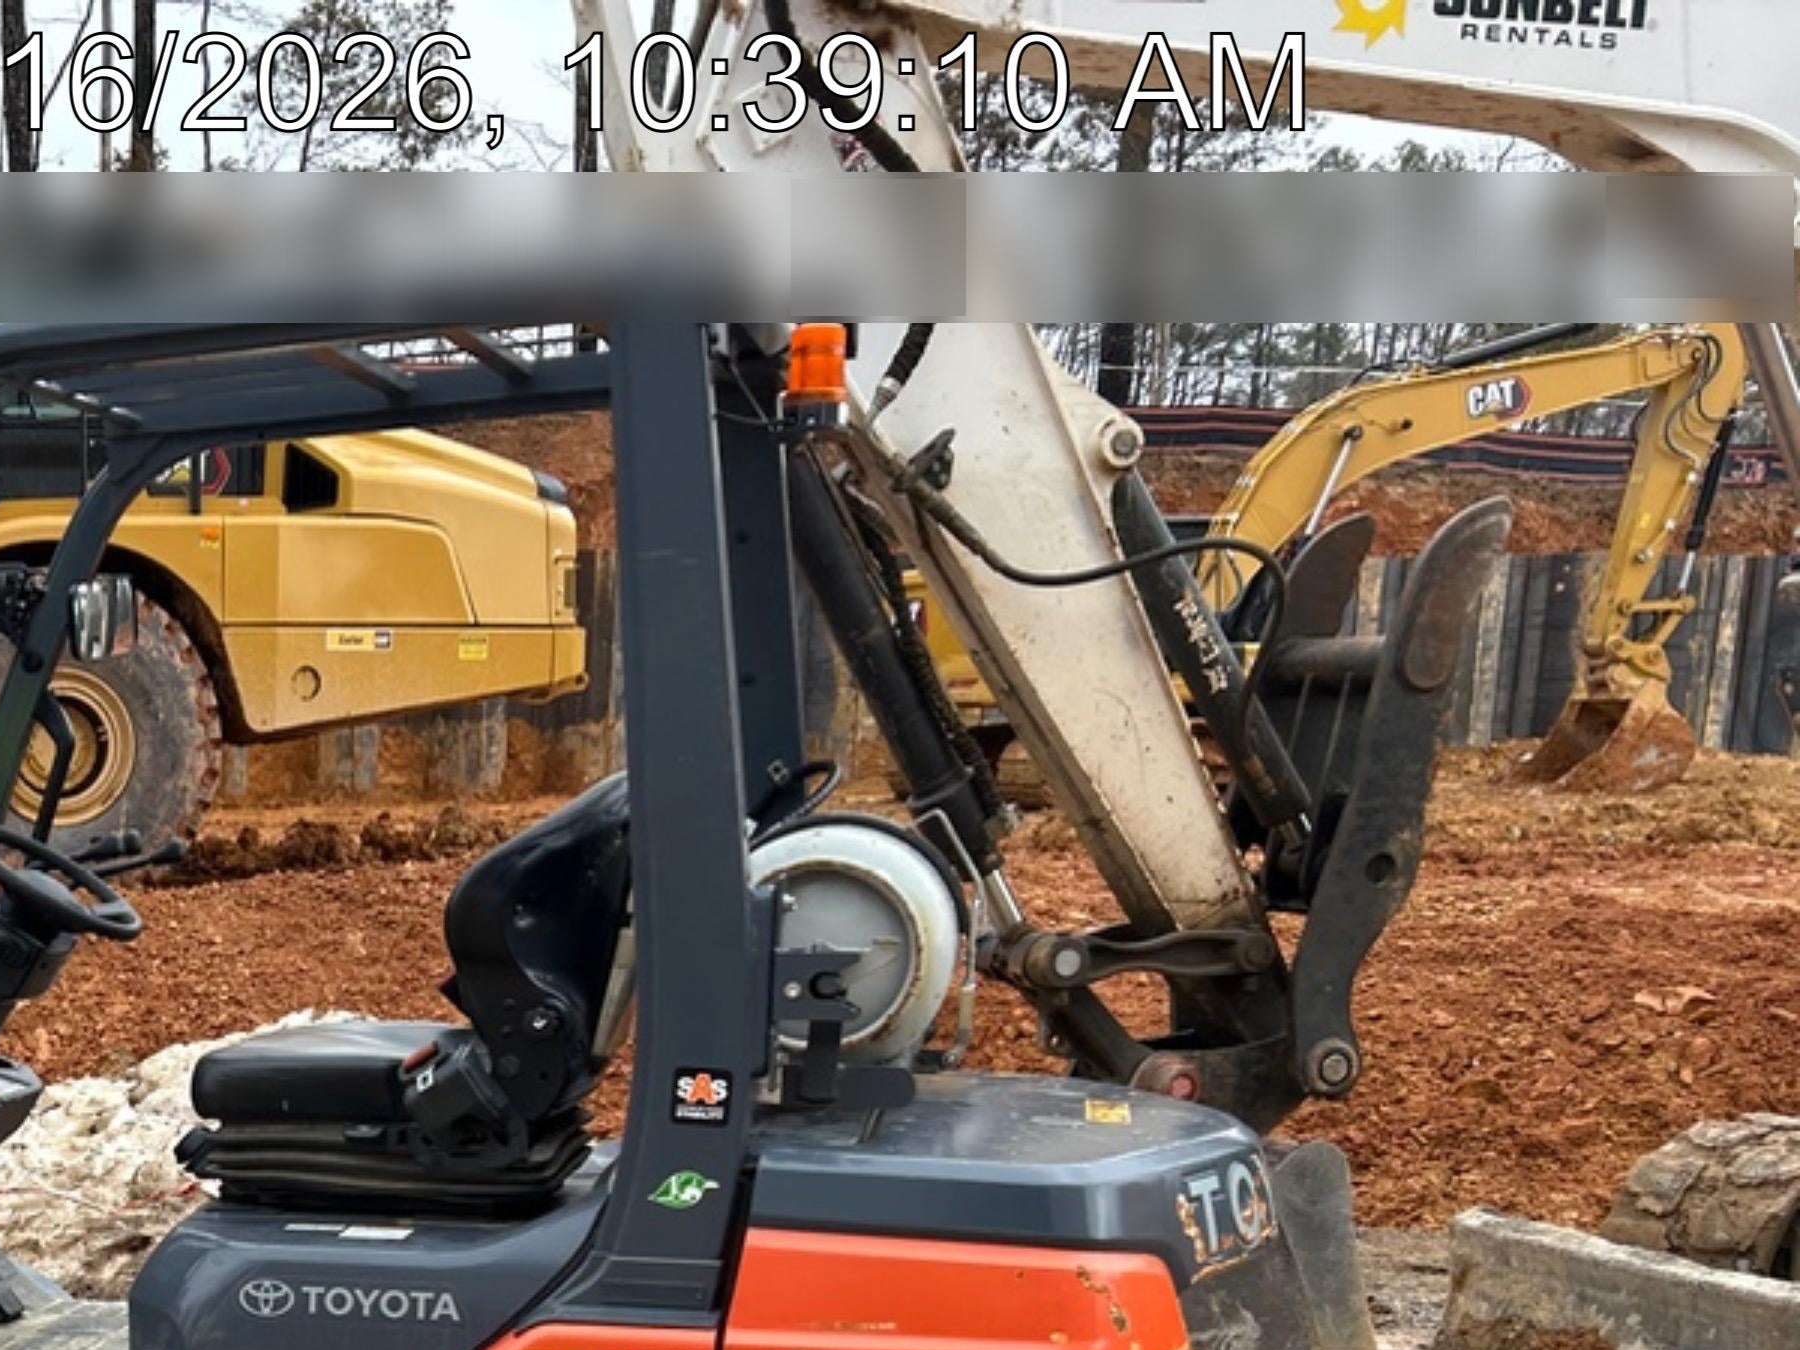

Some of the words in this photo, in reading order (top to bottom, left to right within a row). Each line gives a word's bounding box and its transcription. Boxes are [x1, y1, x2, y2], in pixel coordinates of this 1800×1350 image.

[1460, 24, 1618, 49] RENTALS
[1468, 378, 1516, 416] CAT
[676, 1073, 728, 1105] SAS
[301, 1286, 461, 1322] TOYOTA
